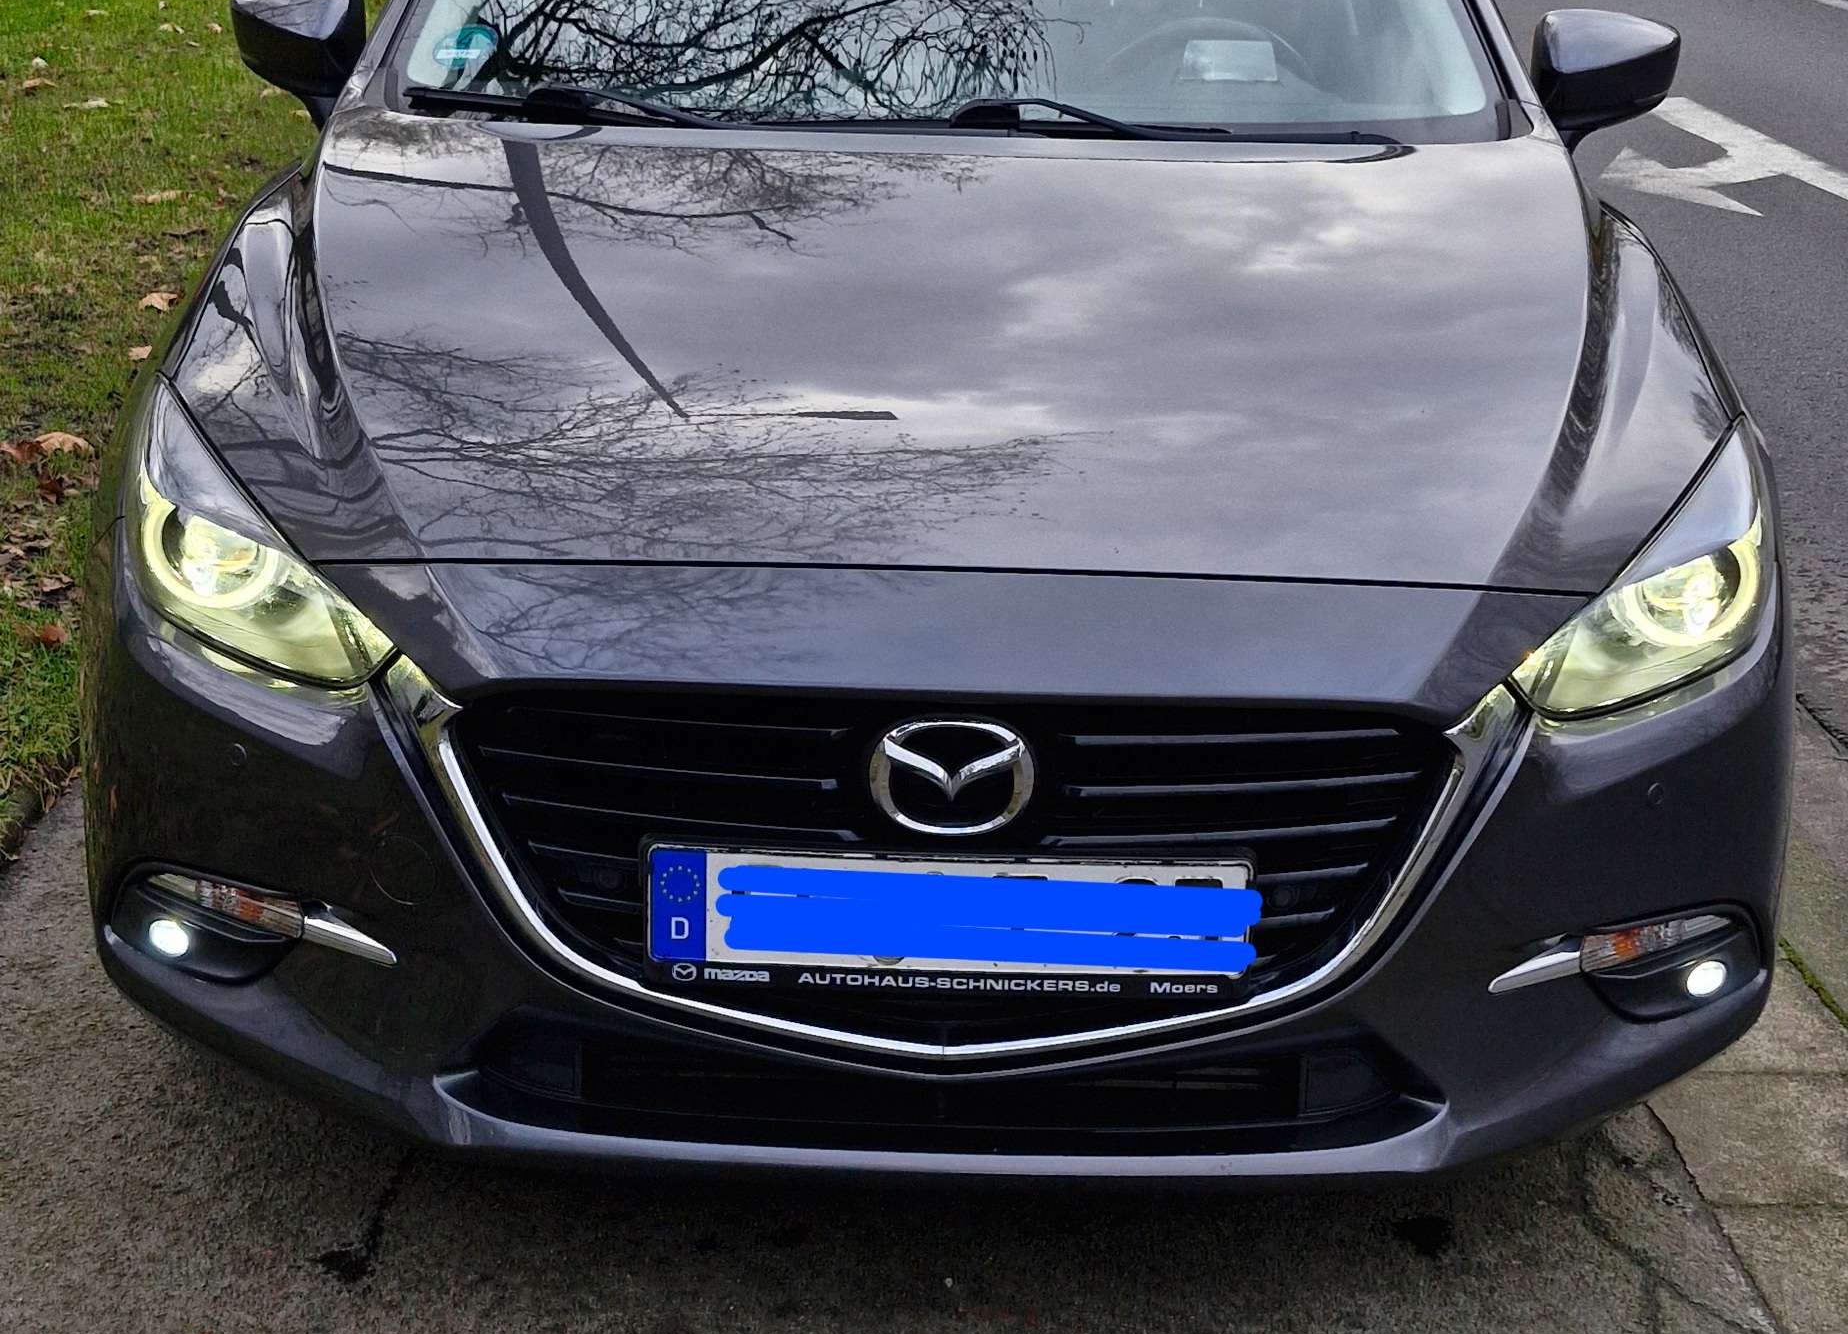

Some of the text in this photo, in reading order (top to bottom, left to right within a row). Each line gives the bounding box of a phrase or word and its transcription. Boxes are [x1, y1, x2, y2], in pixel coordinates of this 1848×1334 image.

[671, 917, 689, 940] D
[798, 973, 1121, 993] AUTOHAUS-SCHNICKERS.de
[1150, 982, 1218, 994] Moers
